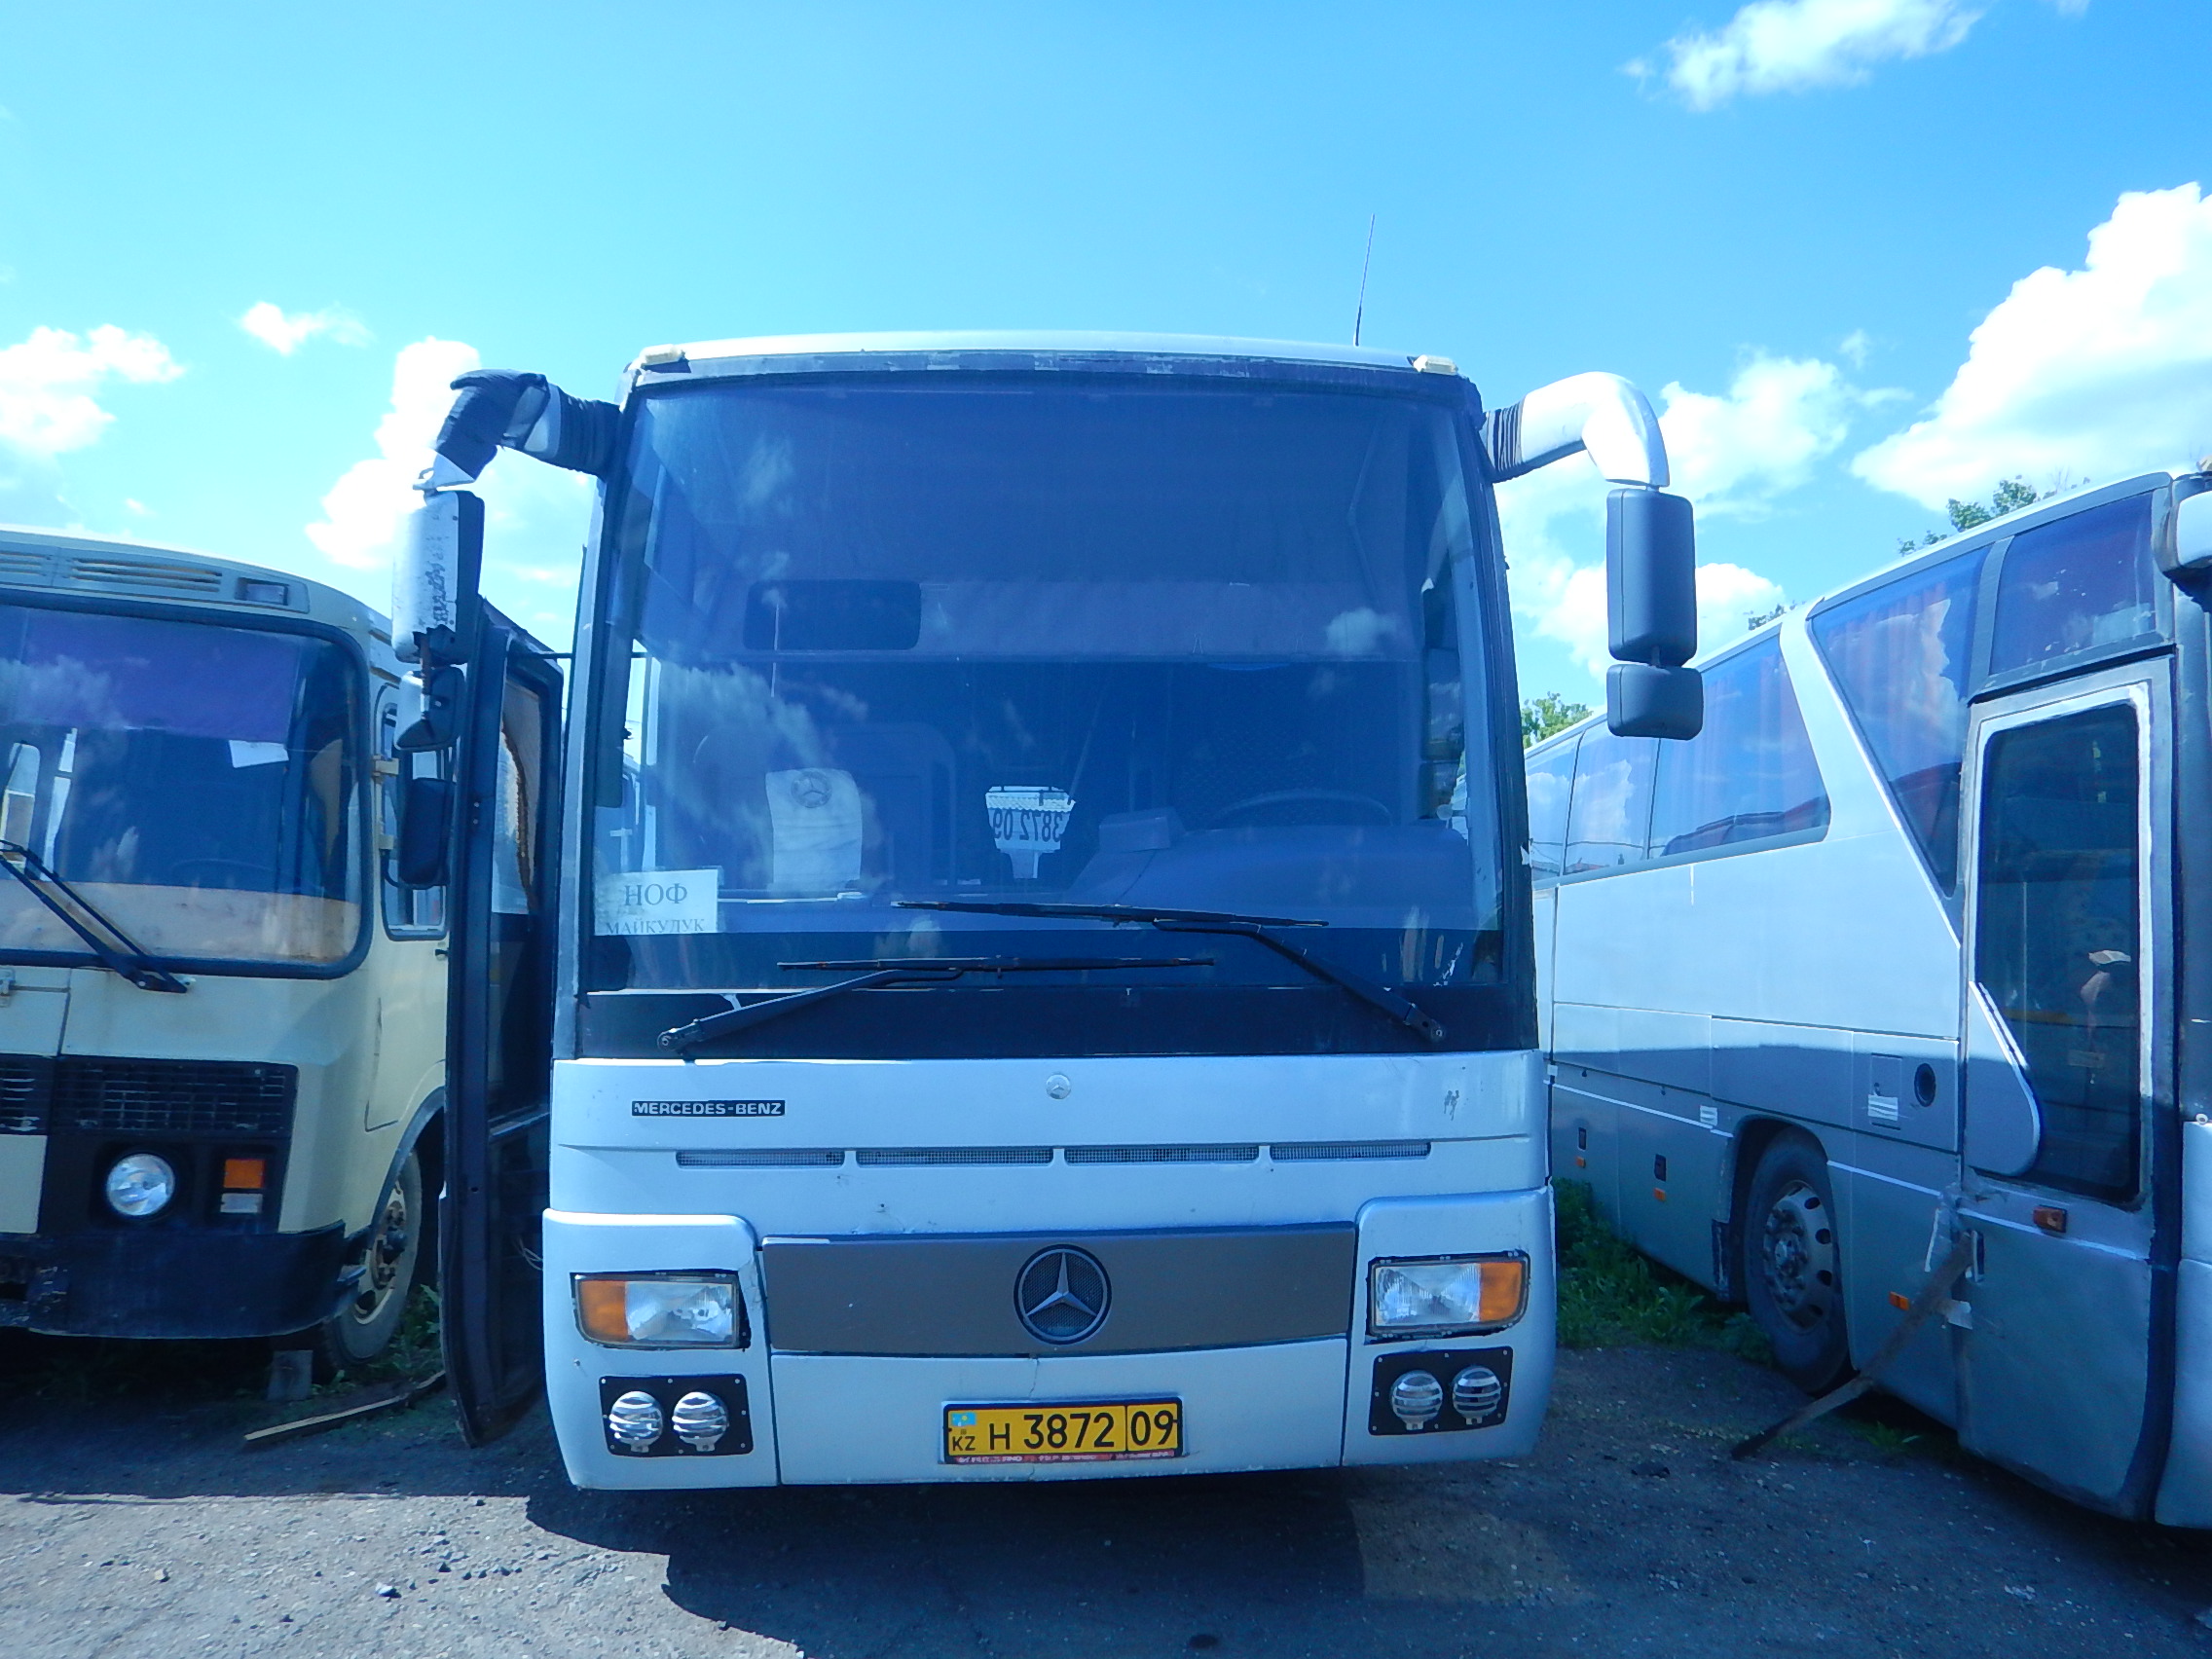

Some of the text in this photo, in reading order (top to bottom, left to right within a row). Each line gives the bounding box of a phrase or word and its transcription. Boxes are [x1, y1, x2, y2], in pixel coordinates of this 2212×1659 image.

[624, 883, 687, 906] НОФ
[634, 1102, 782, 1115] MERCEDES-BENZ
[989, 1409, 1174, 1451] H 3872 09
[952, 1436, 977, 1452] KZ
